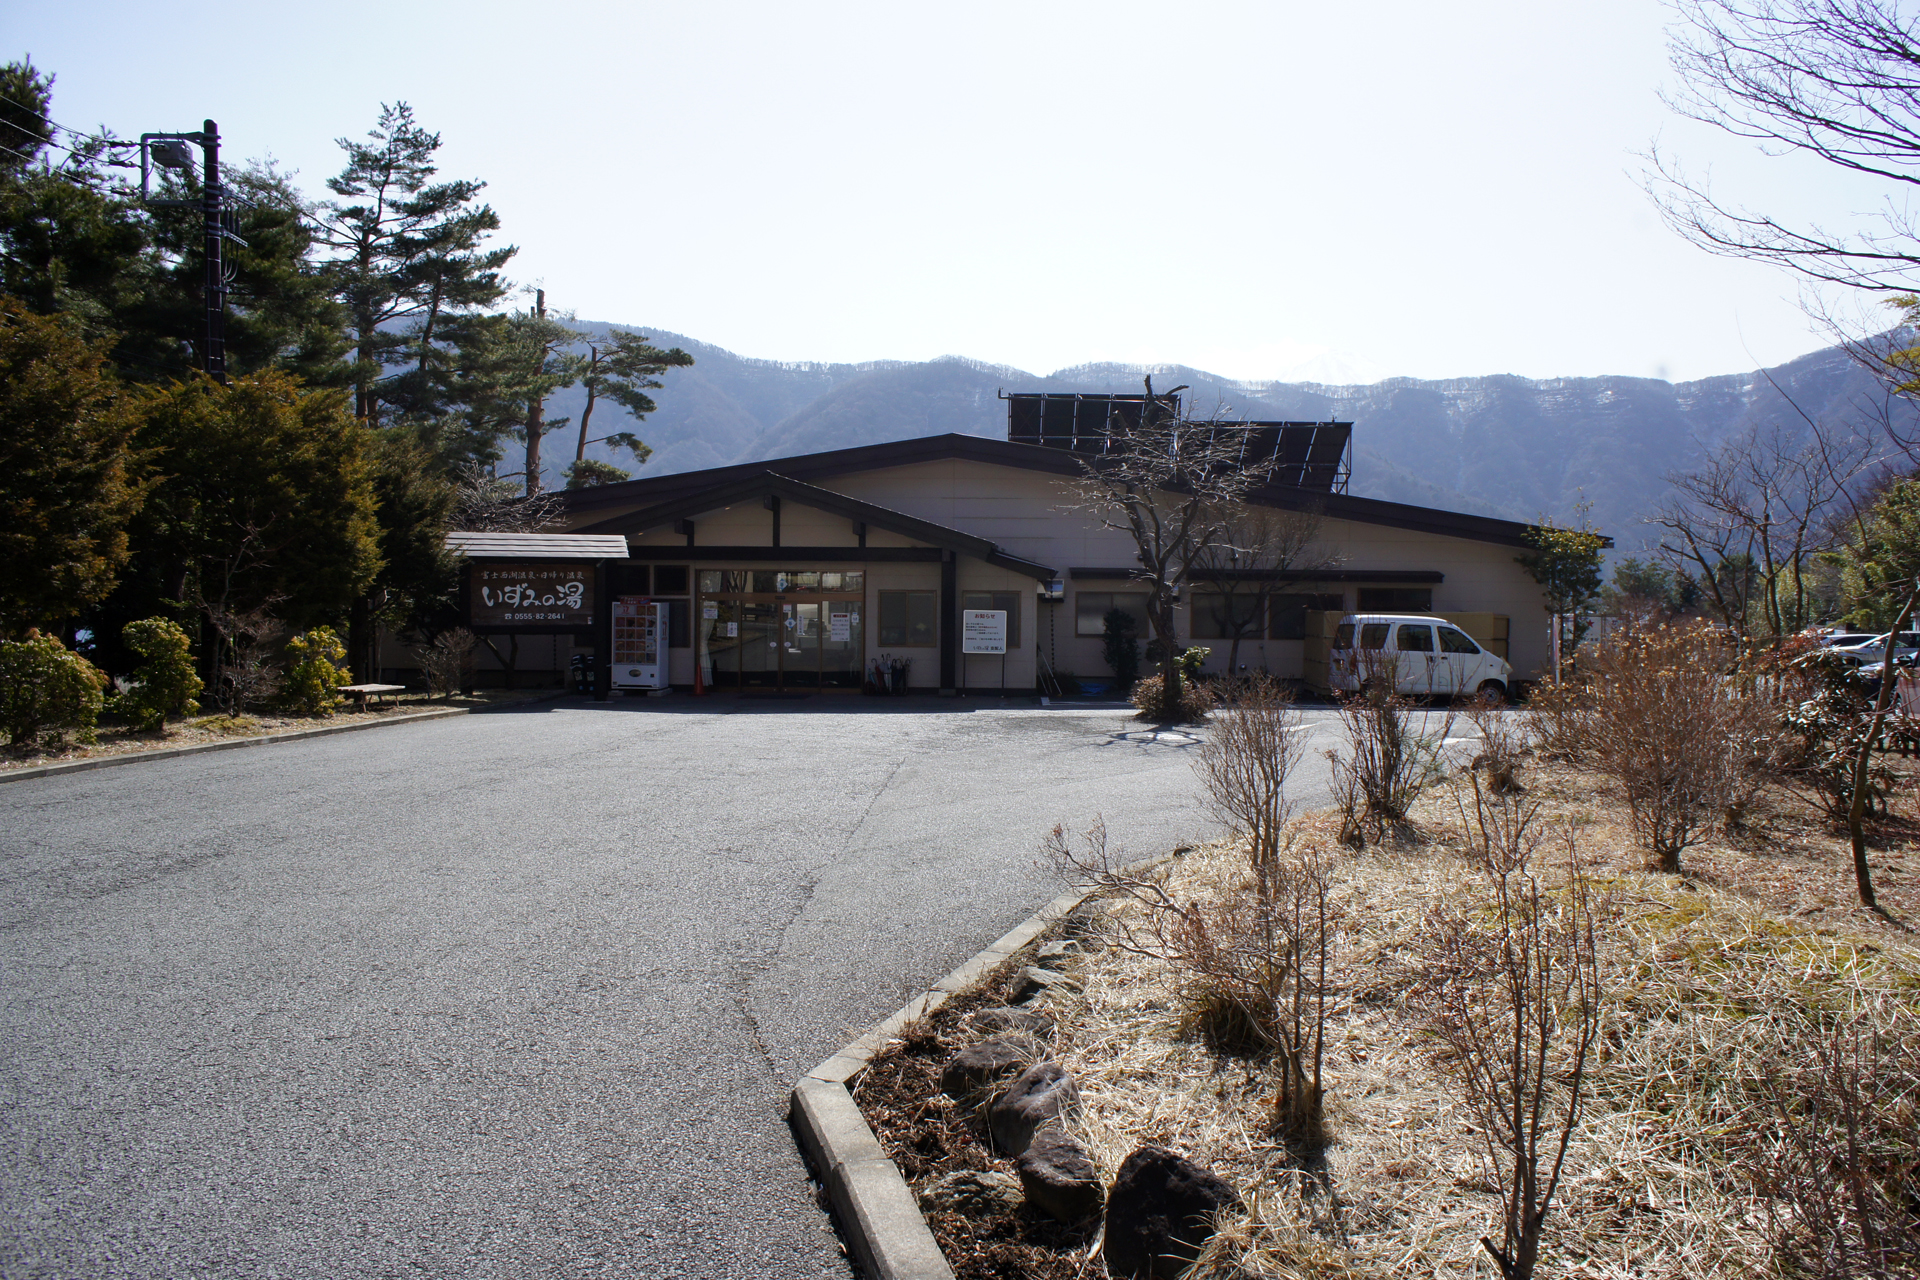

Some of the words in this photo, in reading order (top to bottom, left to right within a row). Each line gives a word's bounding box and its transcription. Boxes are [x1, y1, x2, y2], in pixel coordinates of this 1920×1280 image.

[482, 581, 584, 609] いずみの湯
